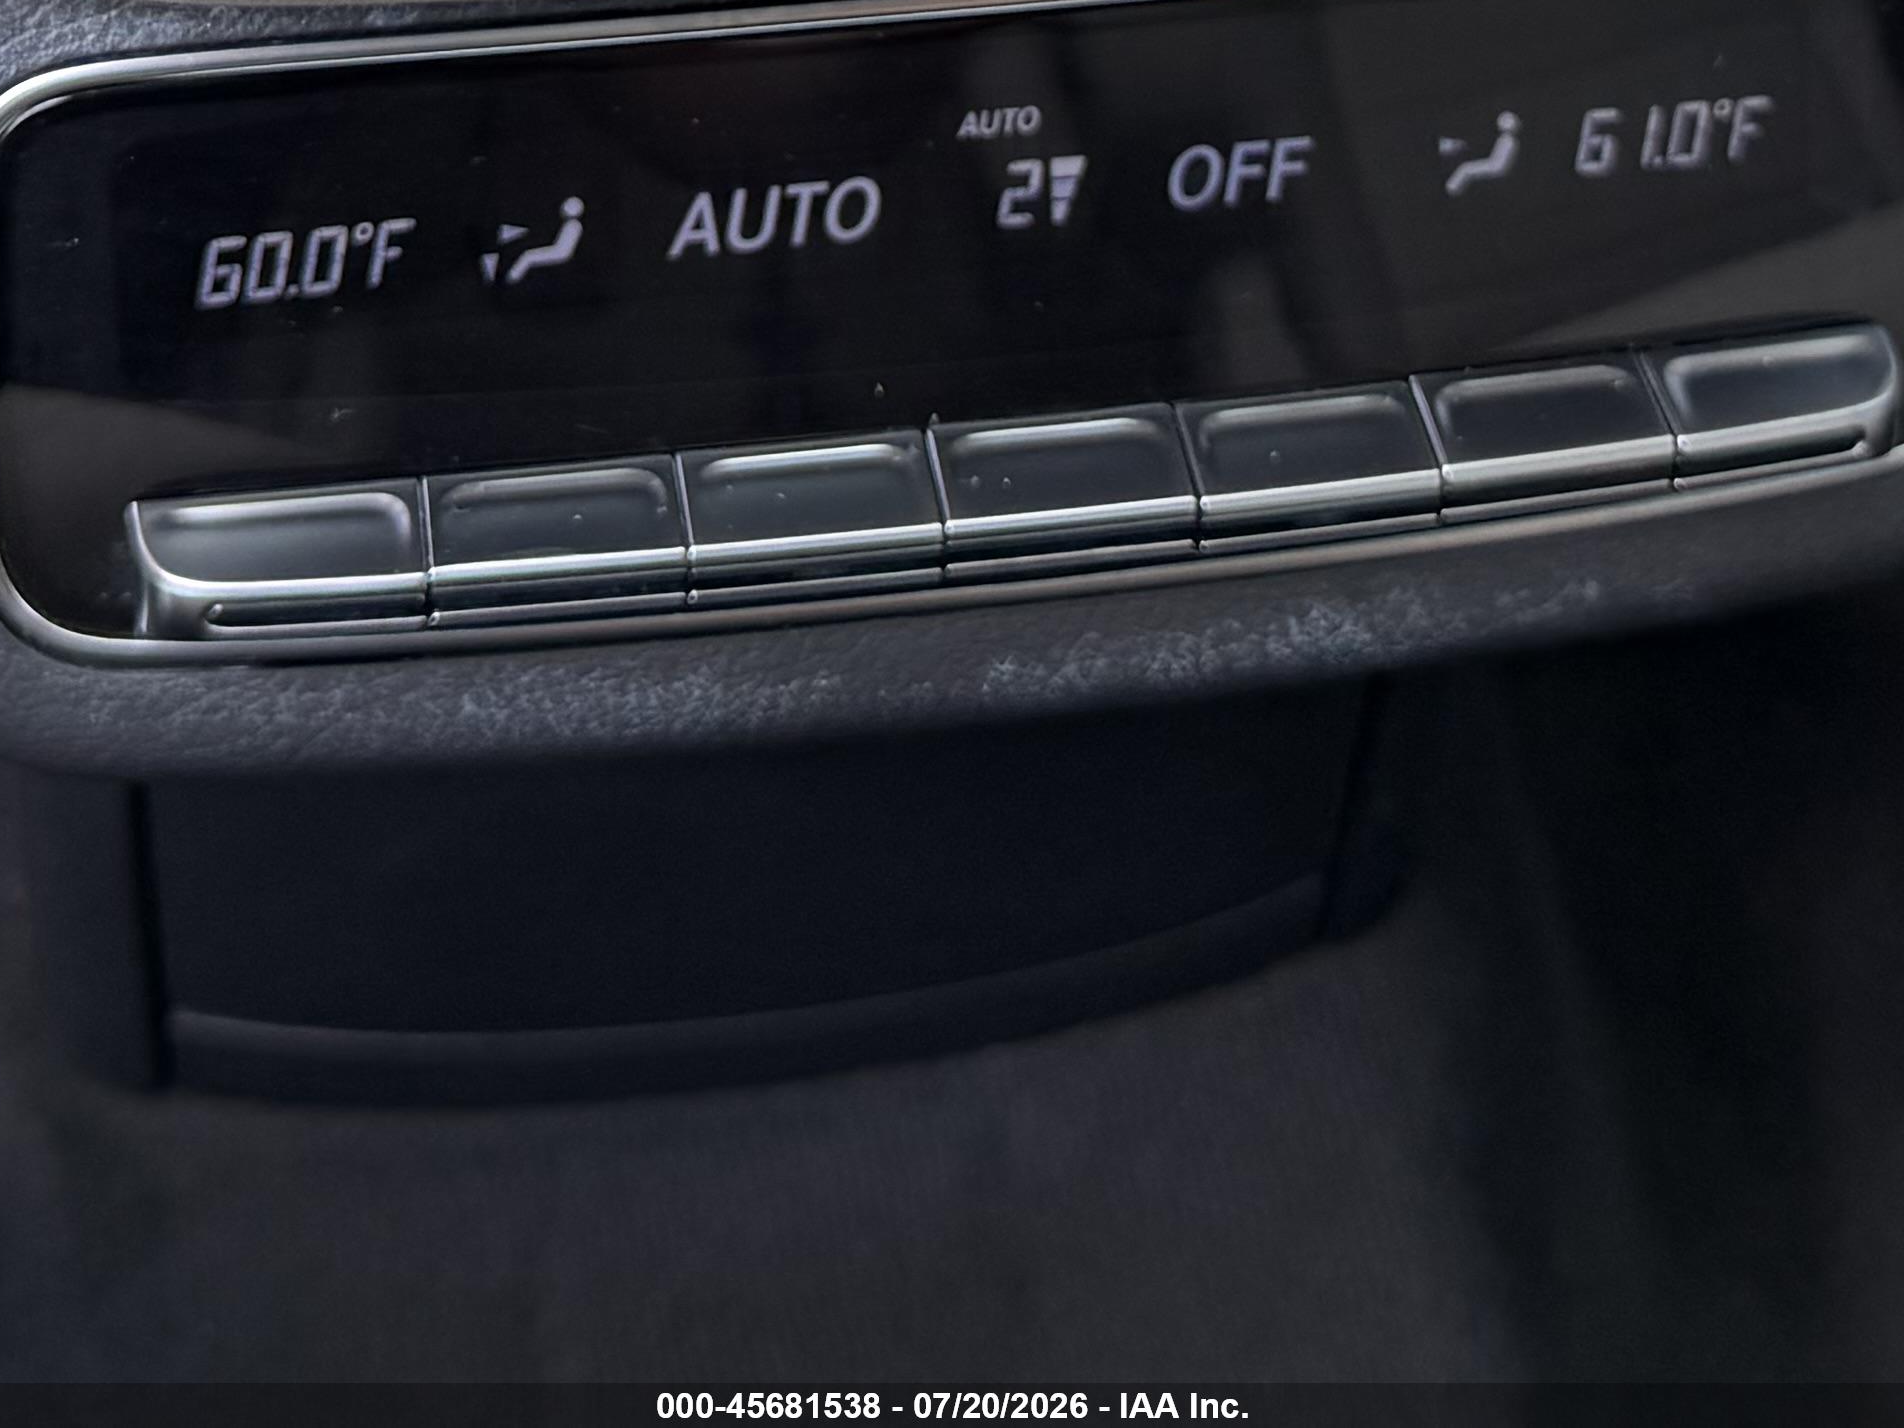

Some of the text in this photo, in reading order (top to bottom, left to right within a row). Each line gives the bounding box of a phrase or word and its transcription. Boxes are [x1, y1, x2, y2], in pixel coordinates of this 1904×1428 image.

[956, 104, 1042, 137] AUTO
[1169, 136, 1311, 207] OFF
[669, 176, 880, 257] AUTO
[198, 217, 416, 308] 60.0°F
